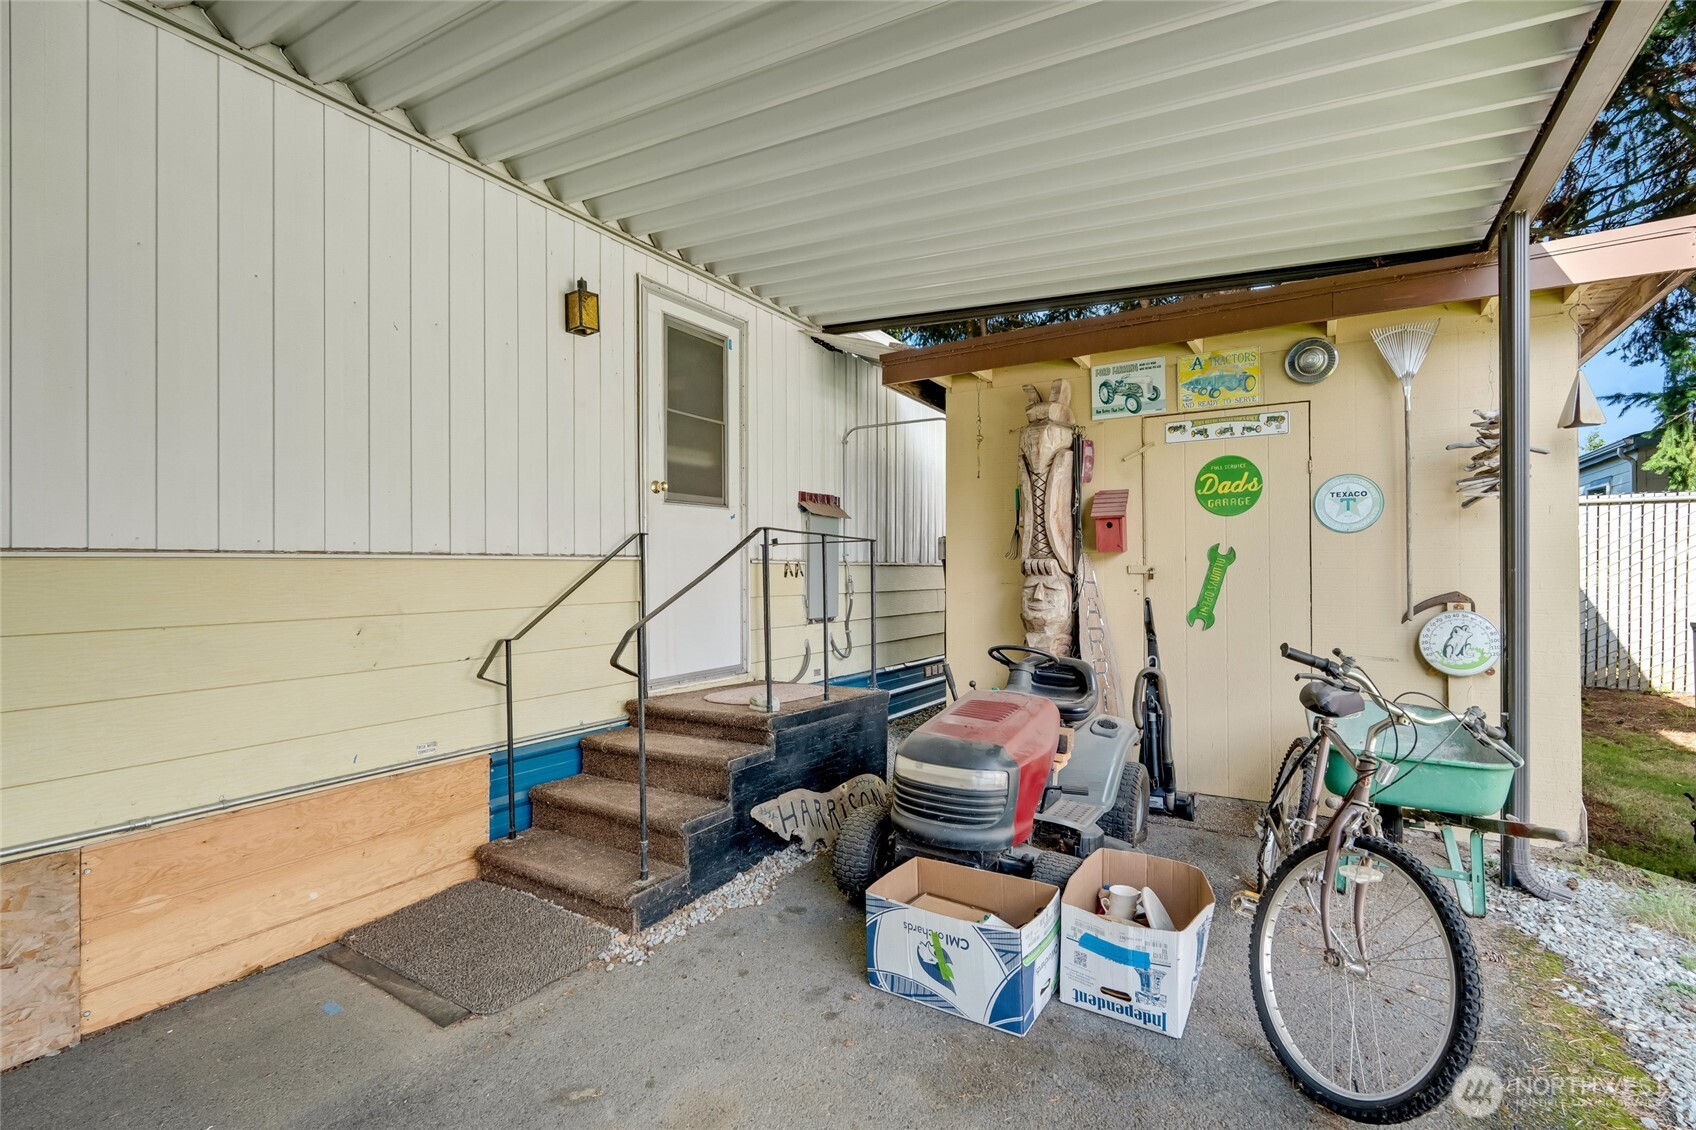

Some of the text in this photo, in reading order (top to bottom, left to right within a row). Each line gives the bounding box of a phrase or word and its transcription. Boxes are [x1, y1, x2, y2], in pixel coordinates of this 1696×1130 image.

[1191, 357, 1203, 370] A
[1209, 352, 1257, 366] TRACTORS
[1095, 367, 1111, 377] FORD
[1112, 364, 1138, 375] FARMING
[1197, 471, 1263, 495] Dads
[1207, 496, 1251, 508] GARAGE
[1340, 498, 1356, 511] T
[903, 922, 970, 951] CMI ochards
[1072, 988, 1167, 1032] Independent
